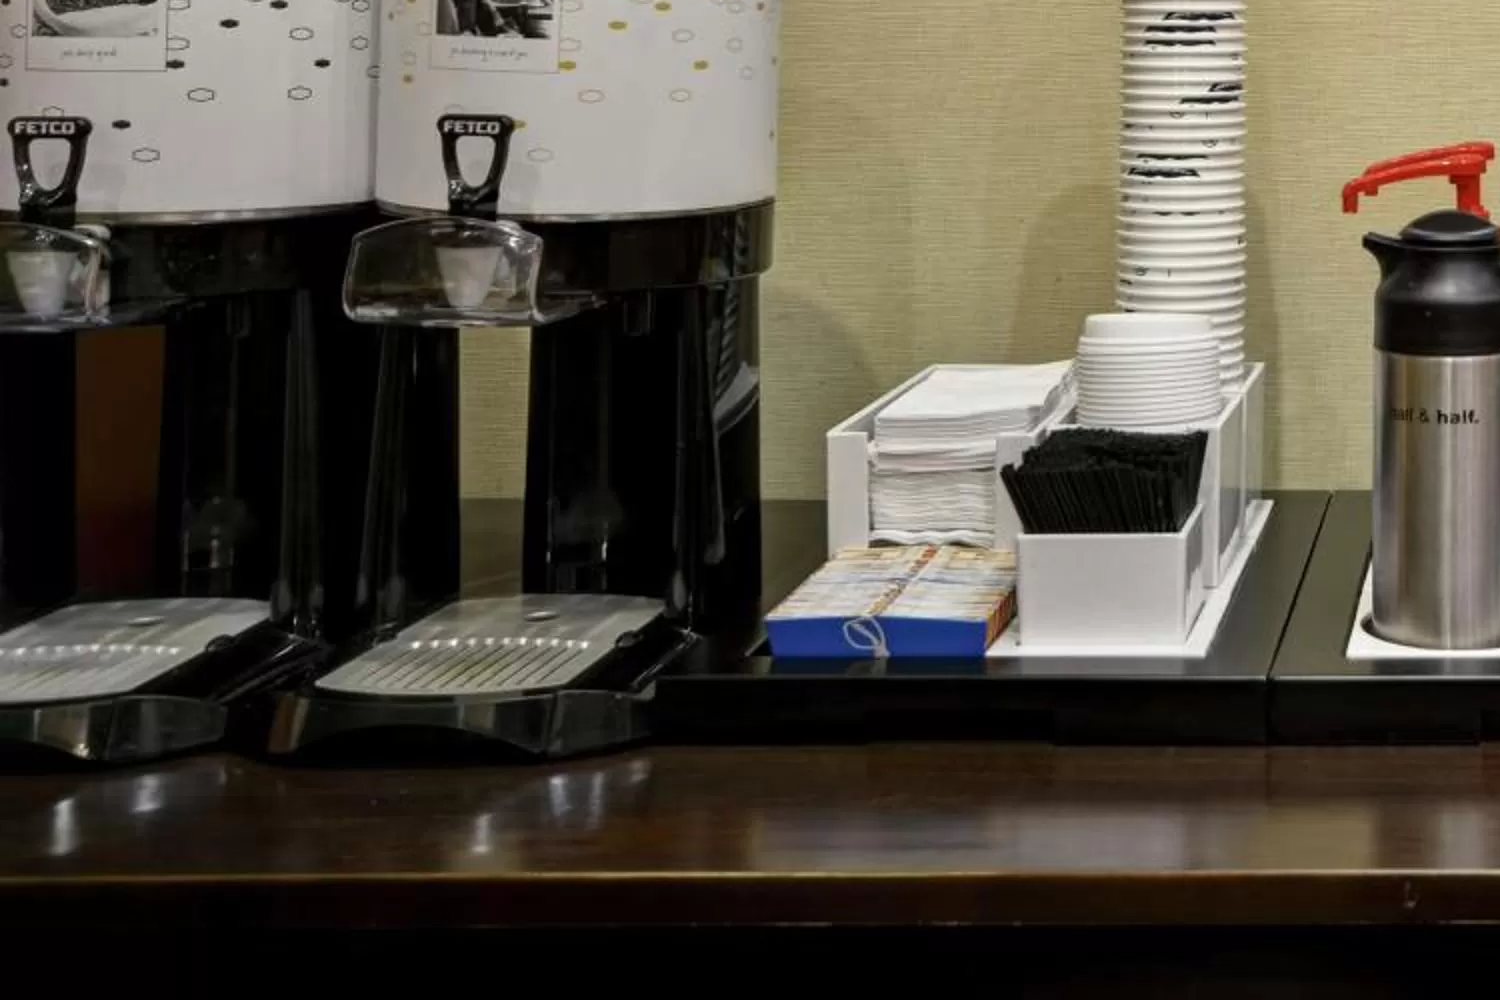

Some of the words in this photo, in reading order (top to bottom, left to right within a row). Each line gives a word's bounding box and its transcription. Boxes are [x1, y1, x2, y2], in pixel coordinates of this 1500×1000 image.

[14, 120, 76, 135] FETCO
[443, 119, 501, 135] FETCO
[1436, 408, 1480, 424] half.
